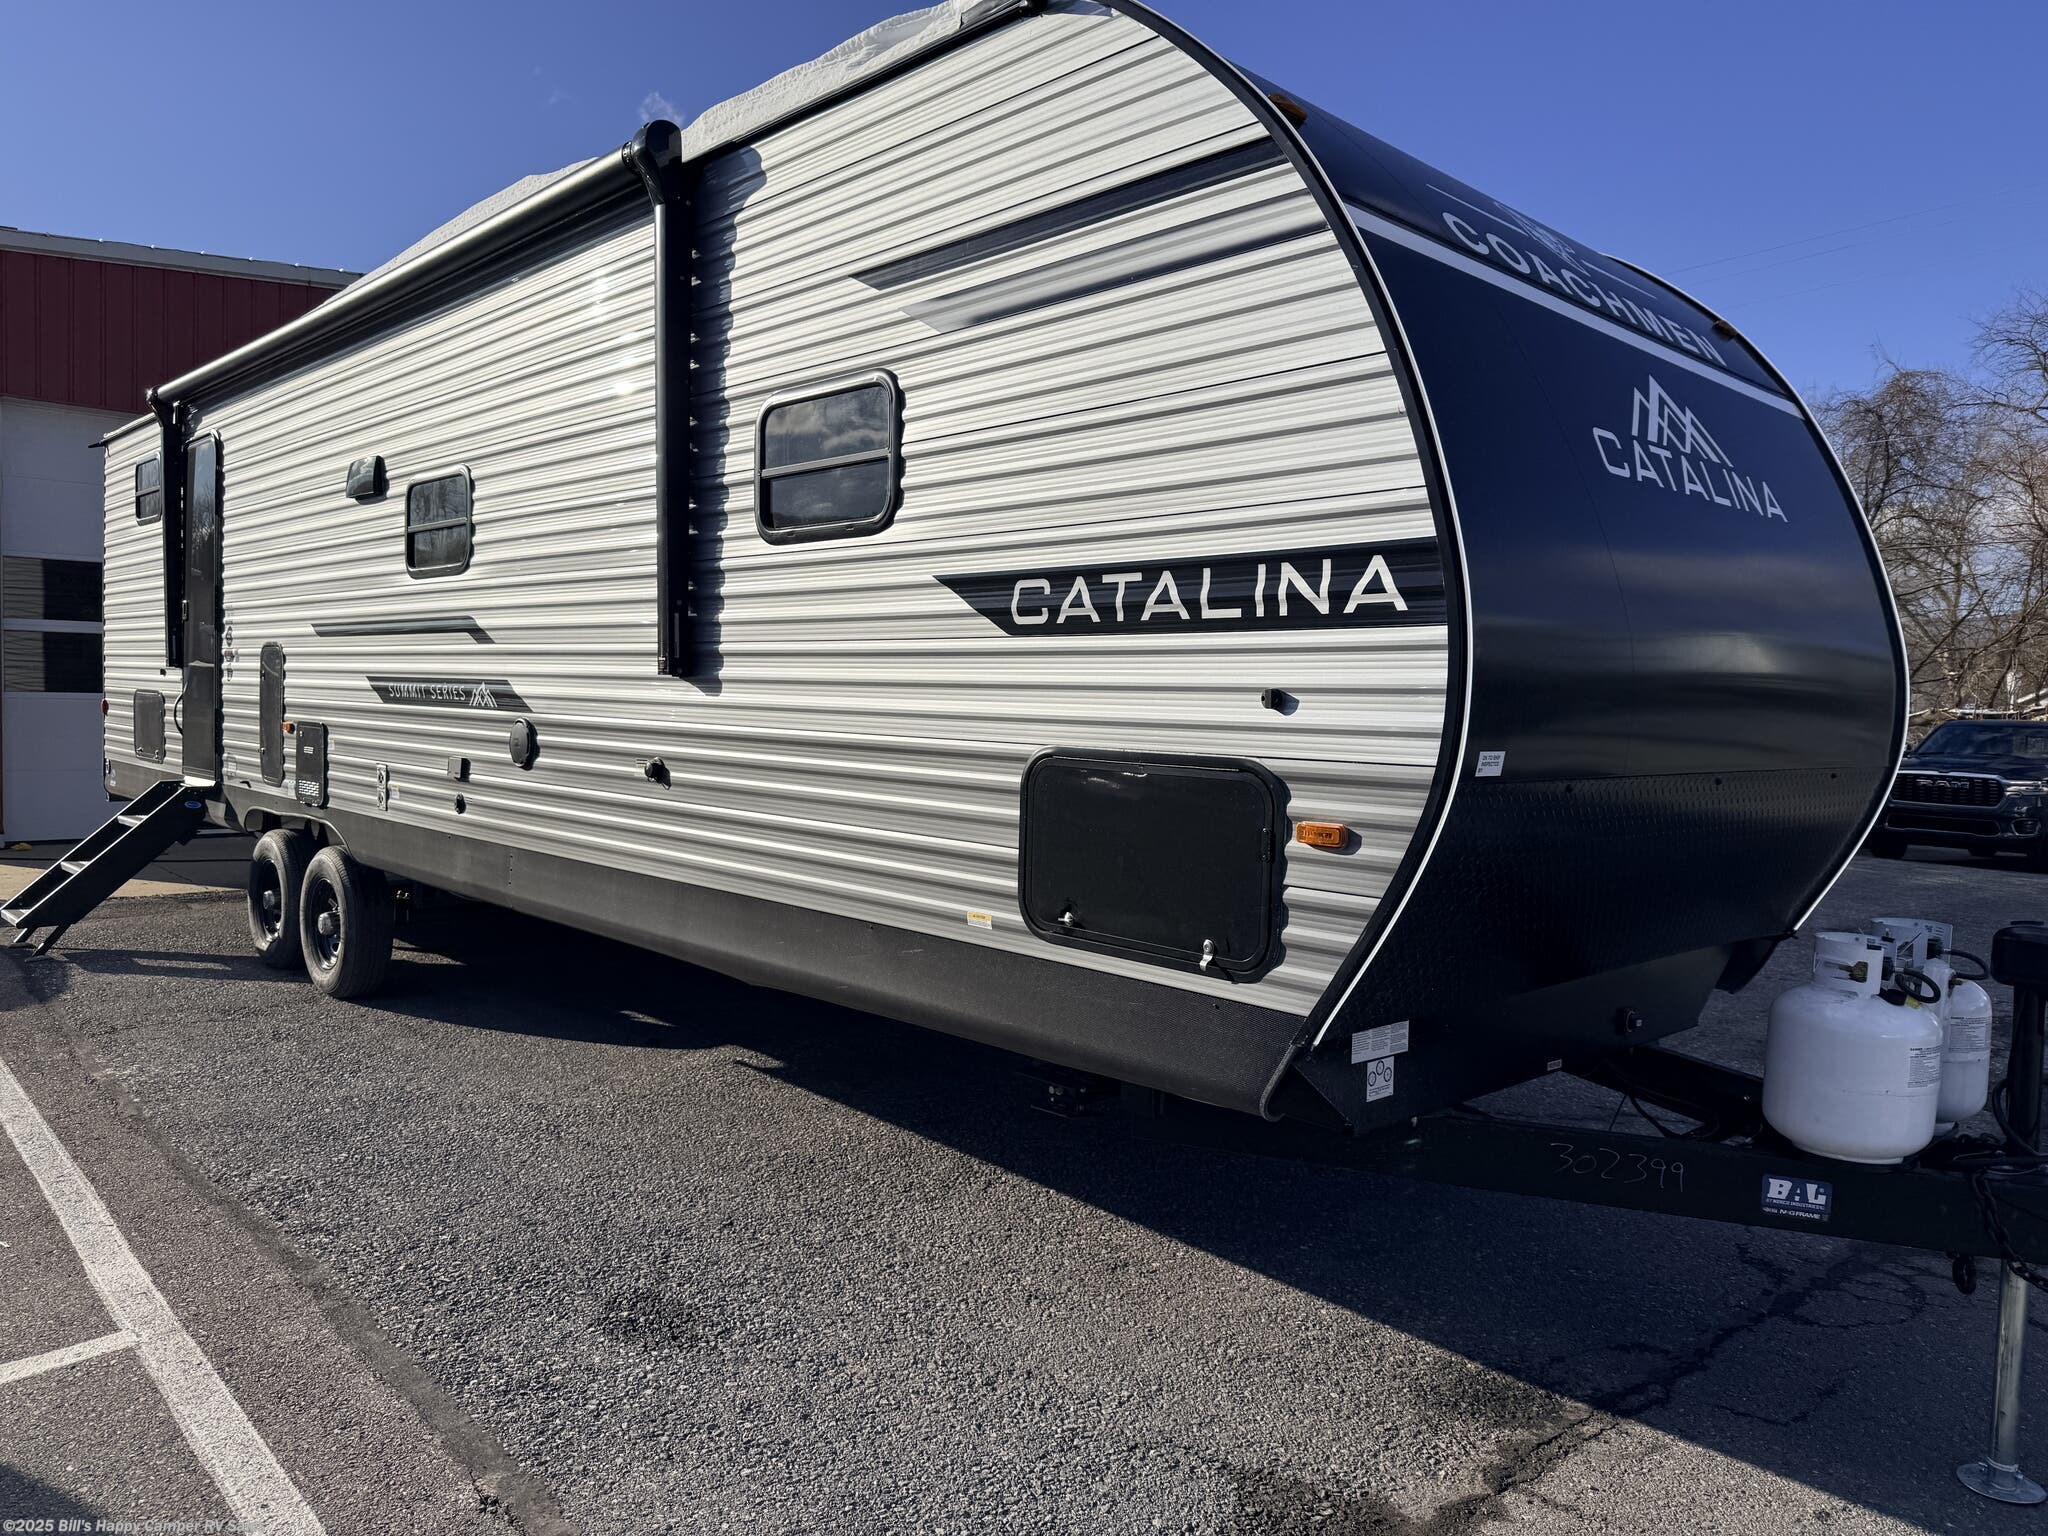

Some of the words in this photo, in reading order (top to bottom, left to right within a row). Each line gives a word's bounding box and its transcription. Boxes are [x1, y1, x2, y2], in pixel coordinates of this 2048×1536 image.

[1442, 211, 1727, 367] COACHMEN
[1592, 426, 1790, 522] CATALINA
[1011, 553, 1408, 625] CATALINA
[388, 684, 427, 699] SUMMIT
[430, 683, 466, 701] SERIES
[1550, 1142, 1684, 1193] 302399
[1767, 1178, 1827, 1205] BAL
